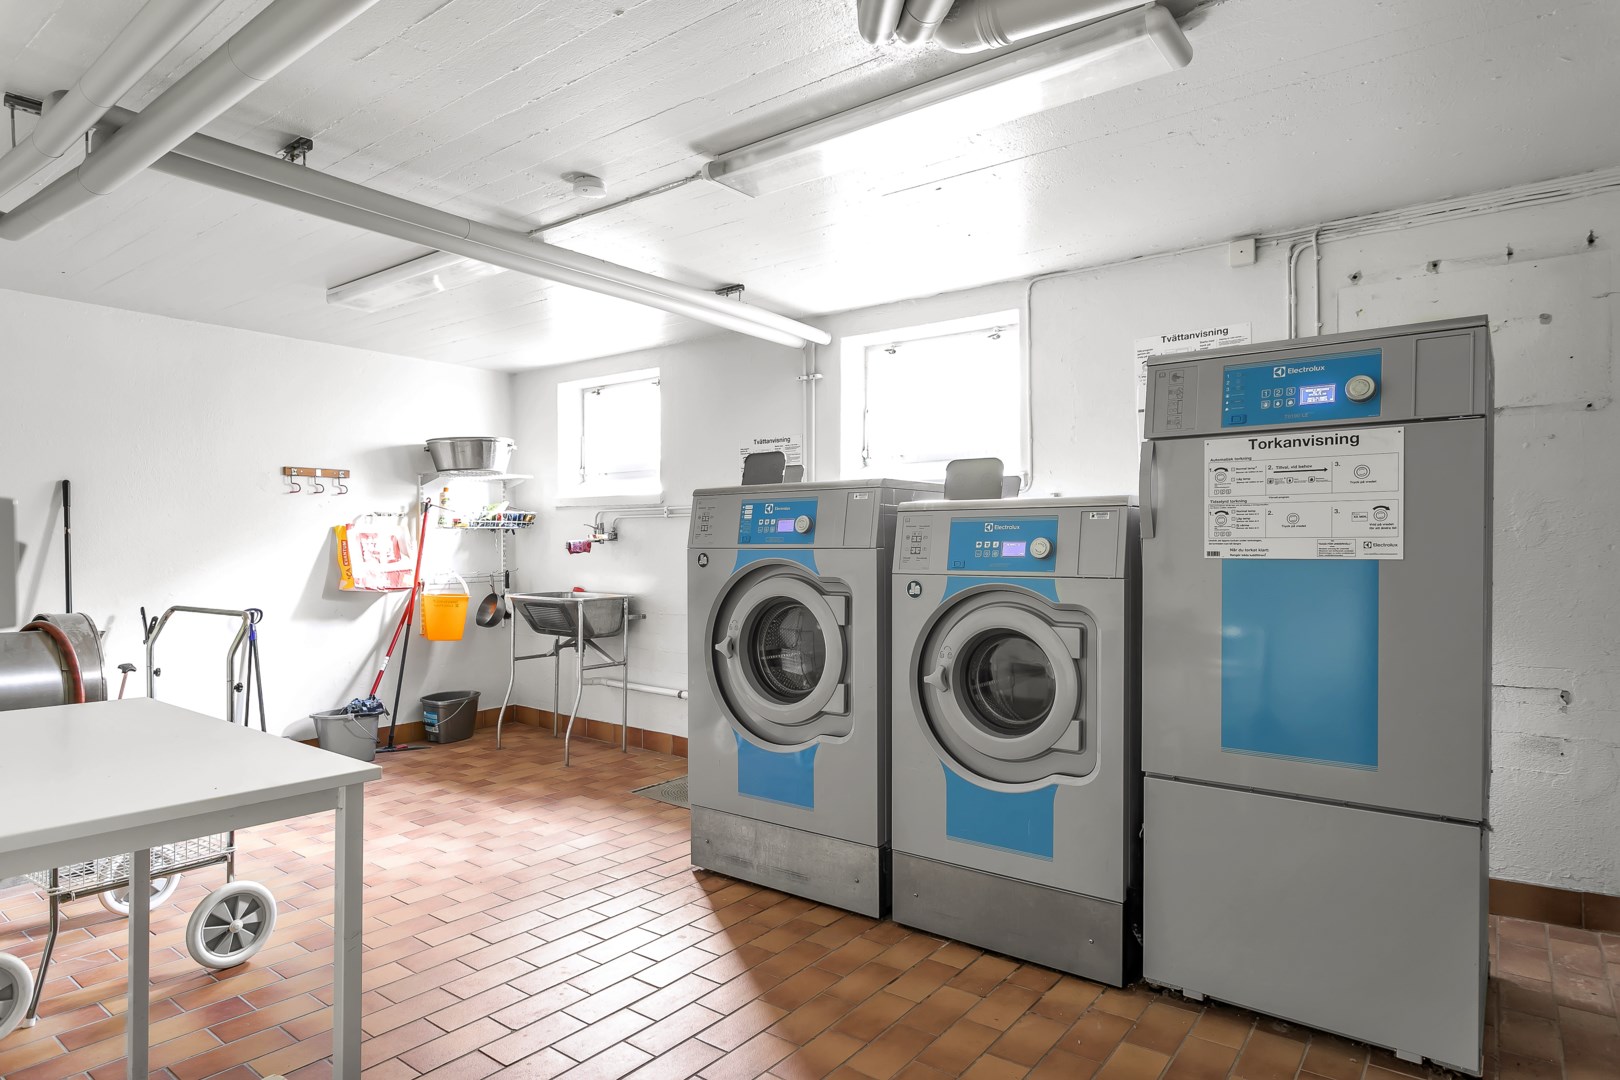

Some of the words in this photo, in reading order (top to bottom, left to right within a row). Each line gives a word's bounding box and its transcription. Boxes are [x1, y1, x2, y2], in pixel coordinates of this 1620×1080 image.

[1161, 328, 1229, 343] Tvättanvisning
[1287, 365, 1325, 374] Electrolux
[1248, 433, 1360, 450] Torkanvisning
